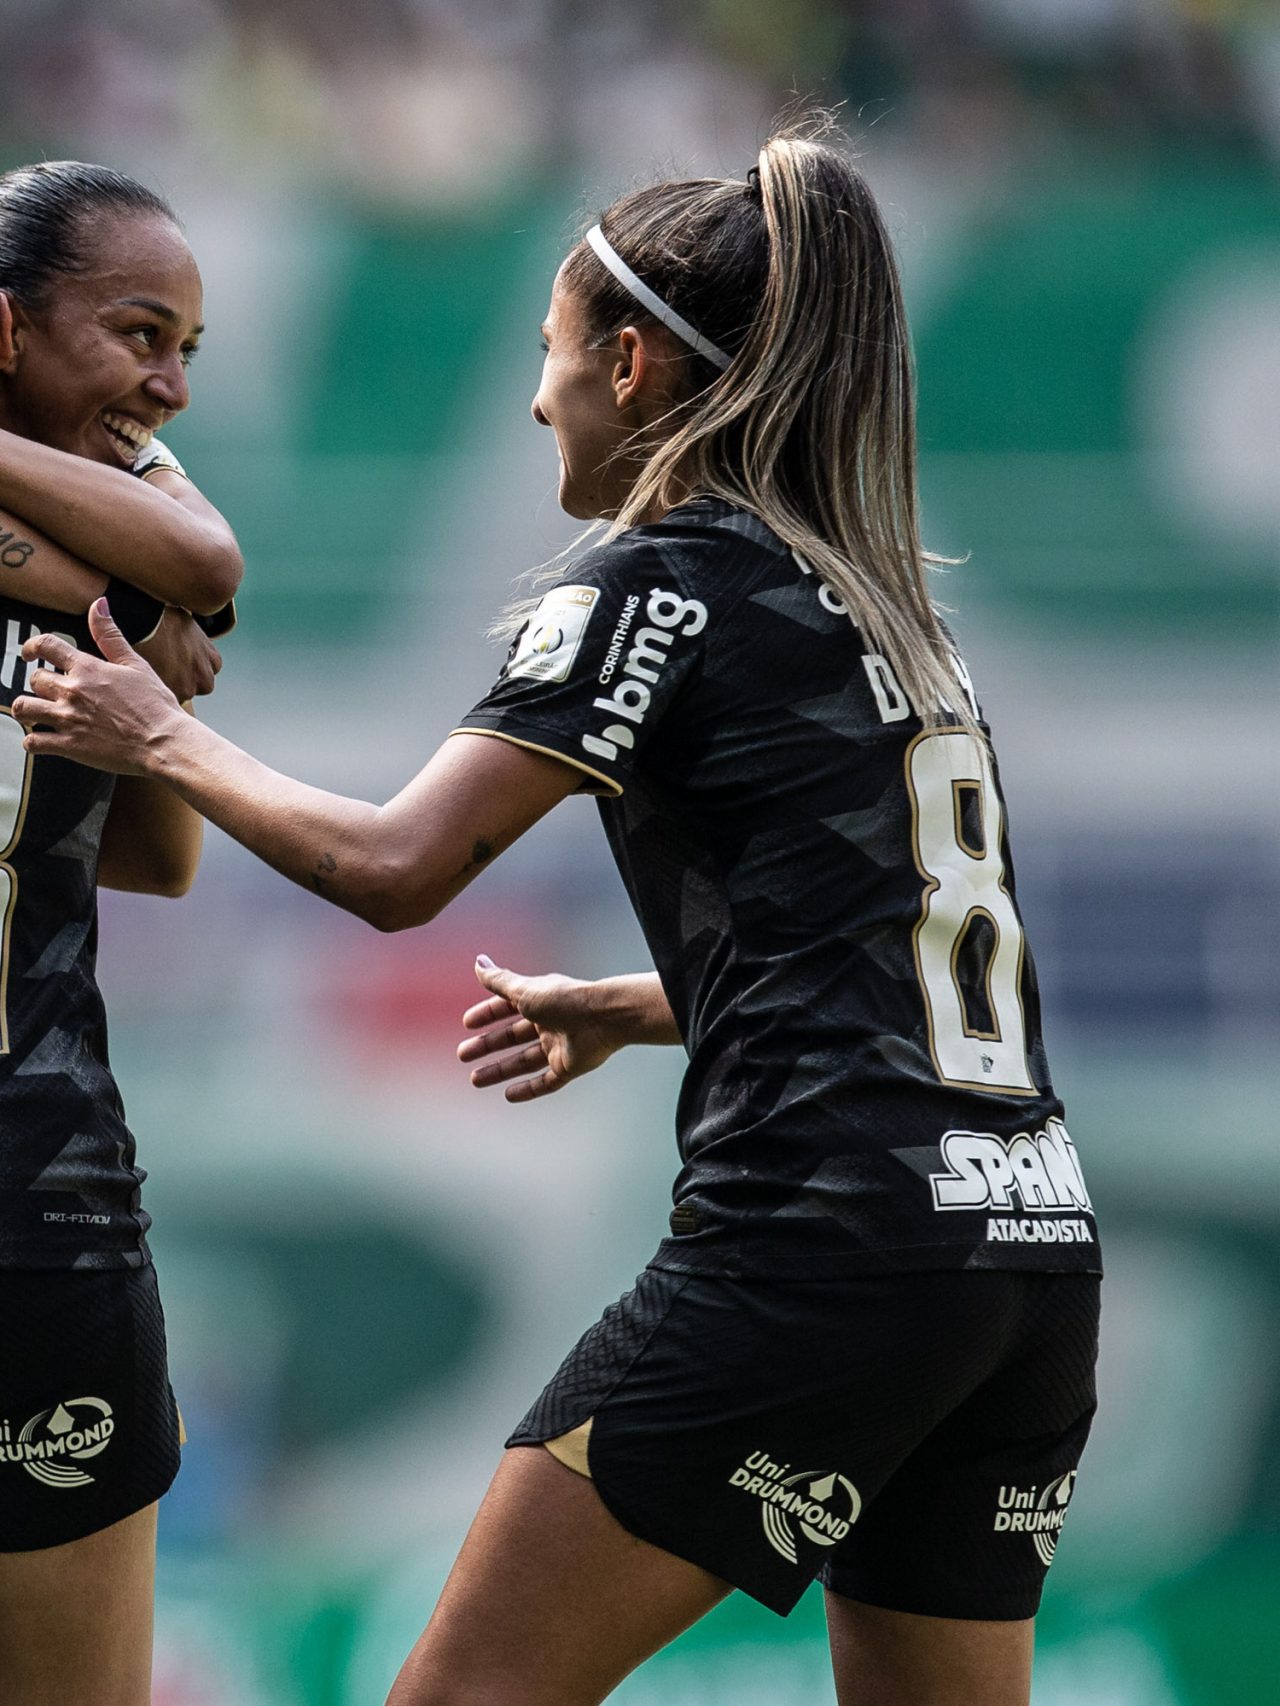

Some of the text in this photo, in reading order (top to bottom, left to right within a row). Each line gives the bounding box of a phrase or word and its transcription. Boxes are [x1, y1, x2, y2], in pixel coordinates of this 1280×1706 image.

[593, 587, 708, 724] bmg
[598, 595, 640, 684] CORINTHIANS
[903, 725, 1041, 1097] 8
[986, 1218, 1094, 1242] ATACADISTA
[744, 1450, 791, 1480] Uni
[998, 1485, 1037, 1508] Uni
[728, 1467, 851, 1541] DRUMMOND
